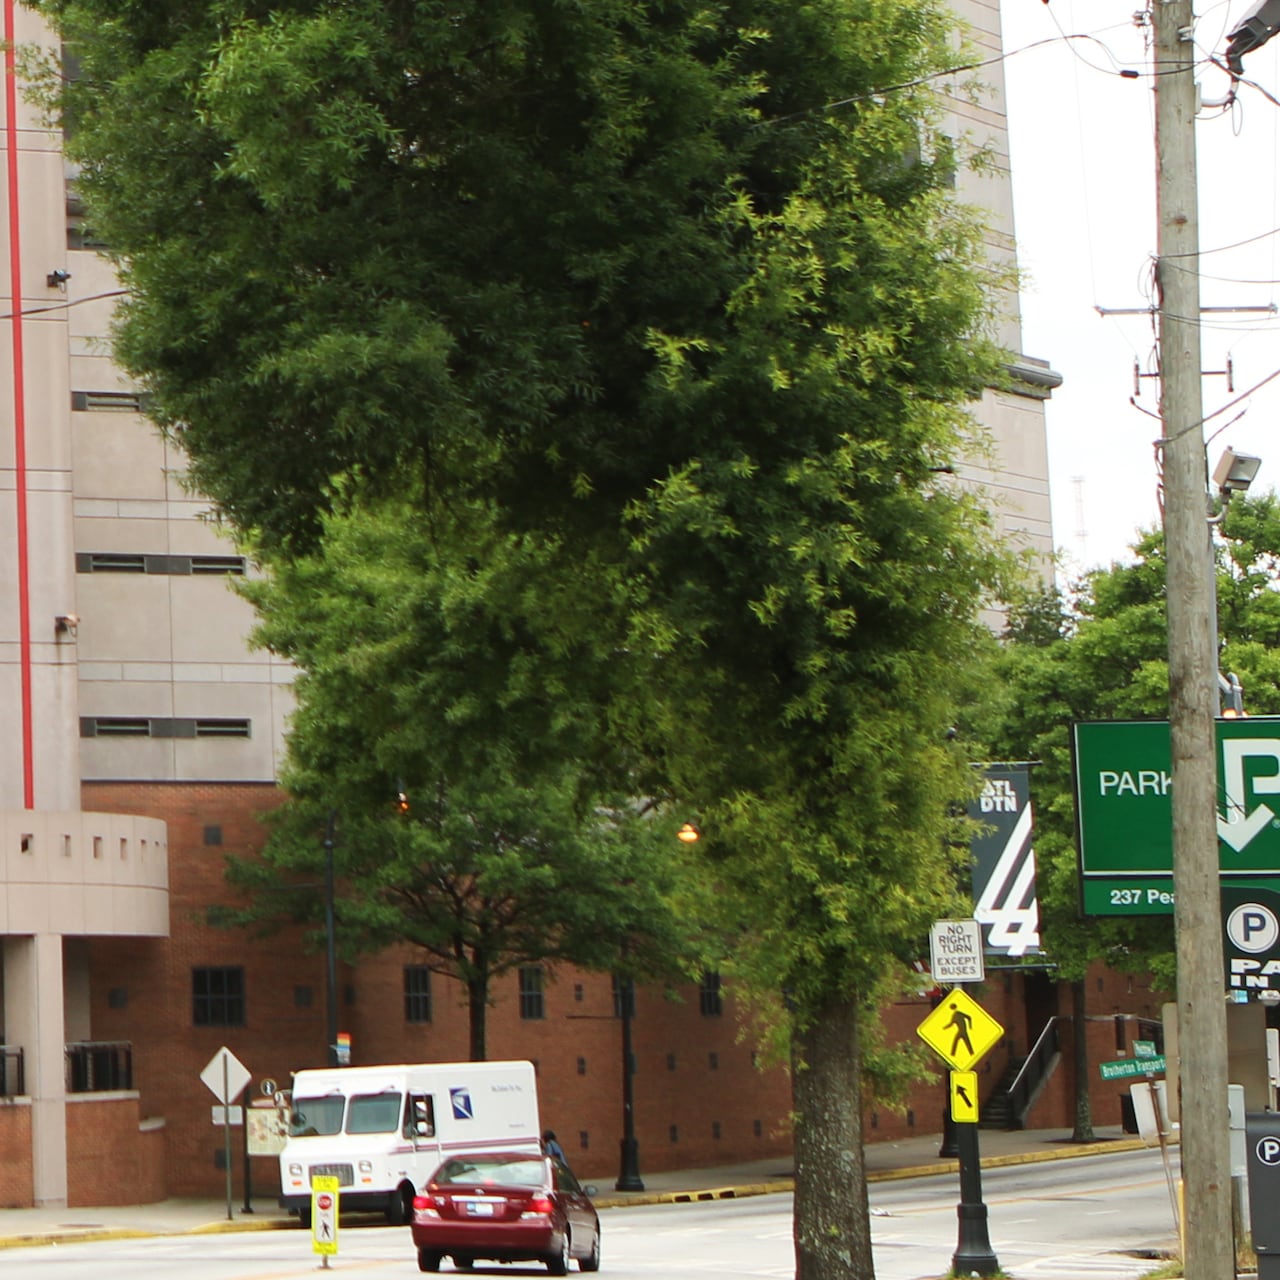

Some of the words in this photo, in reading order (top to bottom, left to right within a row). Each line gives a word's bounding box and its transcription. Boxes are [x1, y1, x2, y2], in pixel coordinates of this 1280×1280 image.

[981, 778, 1016, 797] ATL
[980, 795, 1017, 813] DTN
[1110, 889, 1142, 905] 237
[947, 924, 964, 935] NO
[1242, 911, 1267, 943] P
[938, 934, 973, 945] RIGHT
[941, 944, 973, 954] TURN
[937, 956, 977, 966] EXCEPT
[940, 966, 976, 975] BUSES
[1230, 974, 1269, 988] IN
